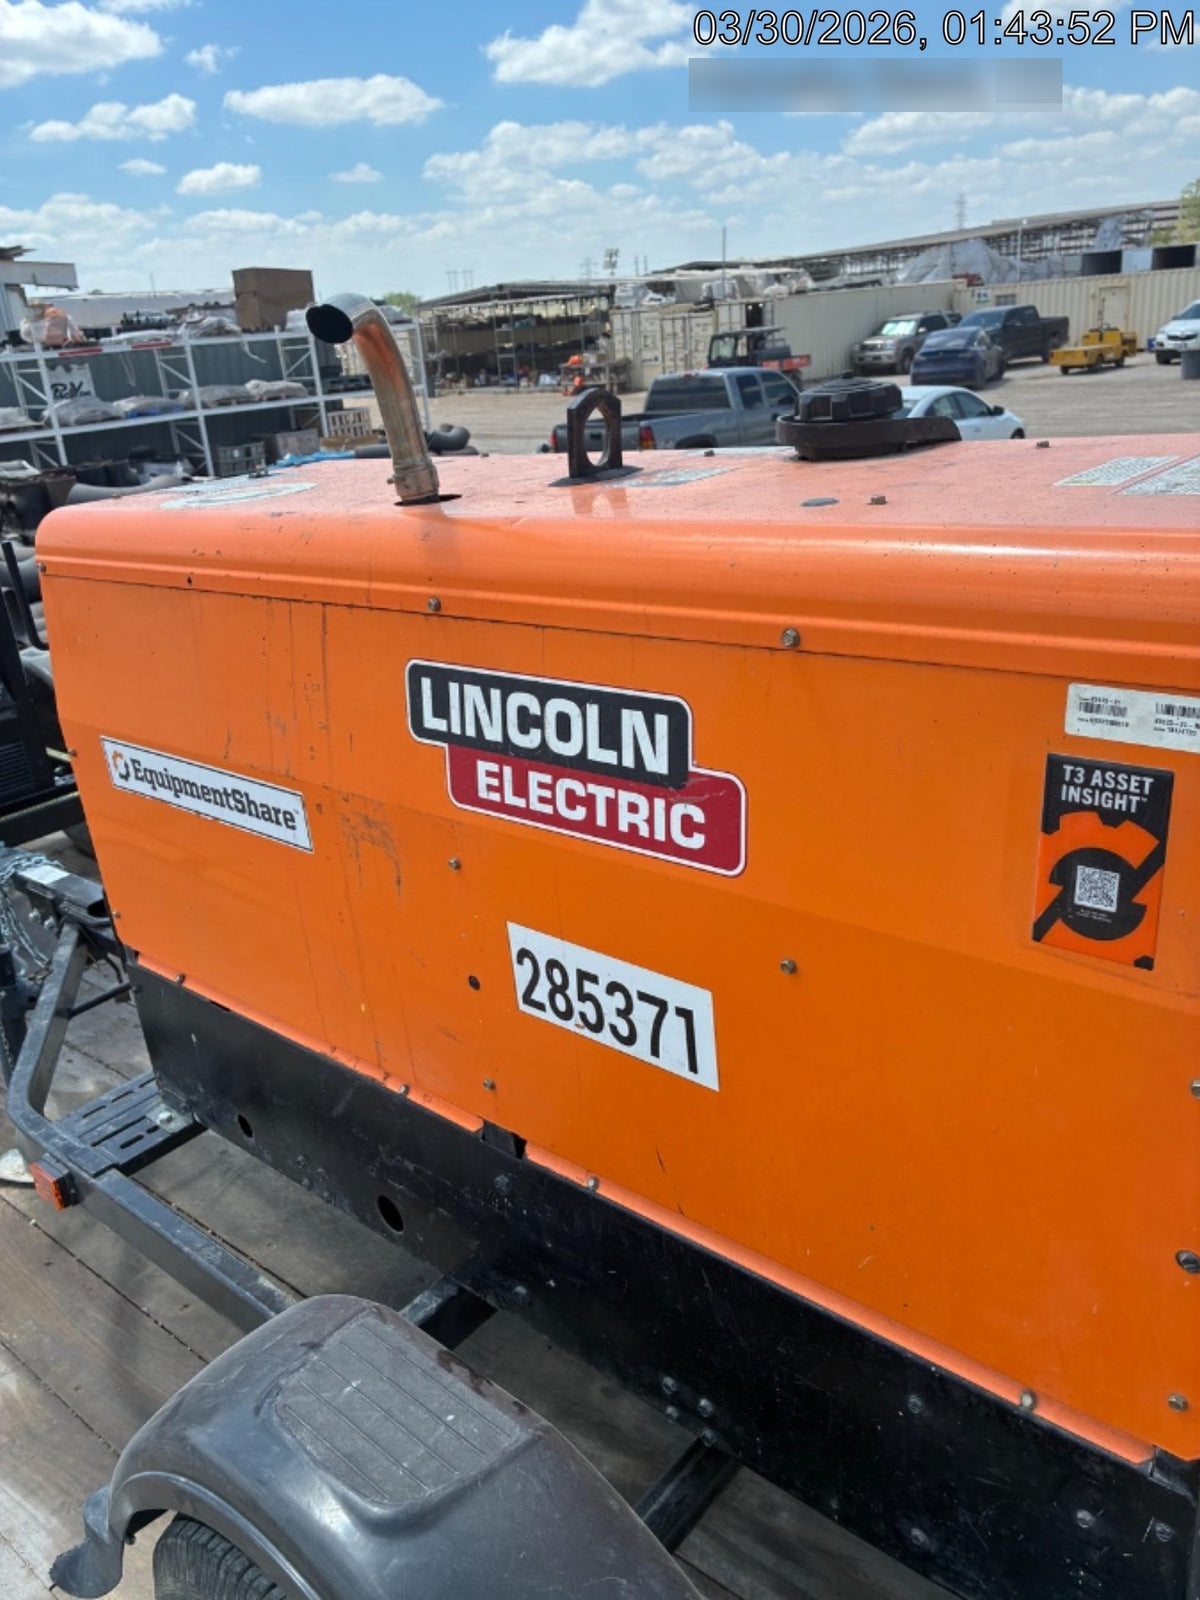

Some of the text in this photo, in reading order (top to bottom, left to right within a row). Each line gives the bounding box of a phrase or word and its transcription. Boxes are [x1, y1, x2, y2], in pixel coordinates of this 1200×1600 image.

[421, 676, 669, 775] LINCOLN
[130, 758, 297, 830] EquipmentShare
[476, 760, 705, 849] ELECTRIC
[1061, 786, 1143, 813] INSIGHT
[1062, 764, 1155, 795] T3 ASSET
[516, 947, 698, 1074] 285371
